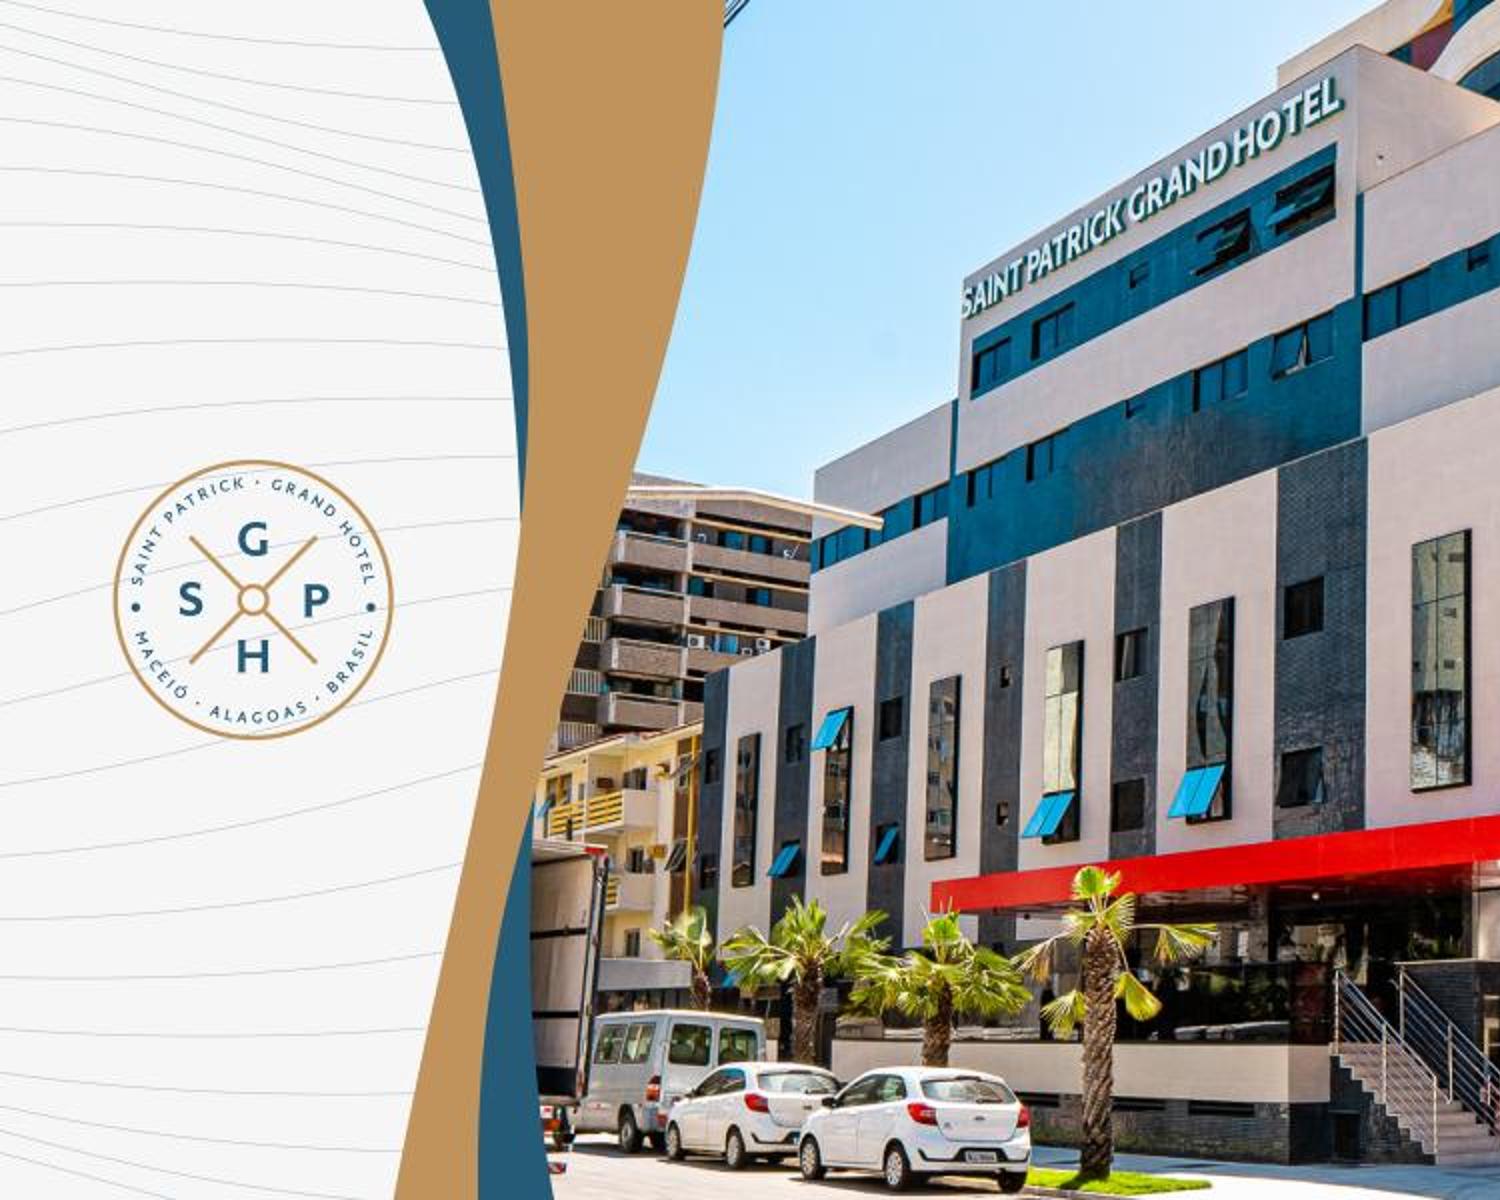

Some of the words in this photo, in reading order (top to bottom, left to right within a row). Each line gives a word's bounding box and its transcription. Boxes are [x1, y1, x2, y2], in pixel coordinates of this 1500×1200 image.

[961, 256, 1025, 320] SAINT
[1026, 199, 1128, 283] PATRICK
[1127, 141, 1230, 223] GRAND
[1232, 76, 1345, 167] HOTEL
